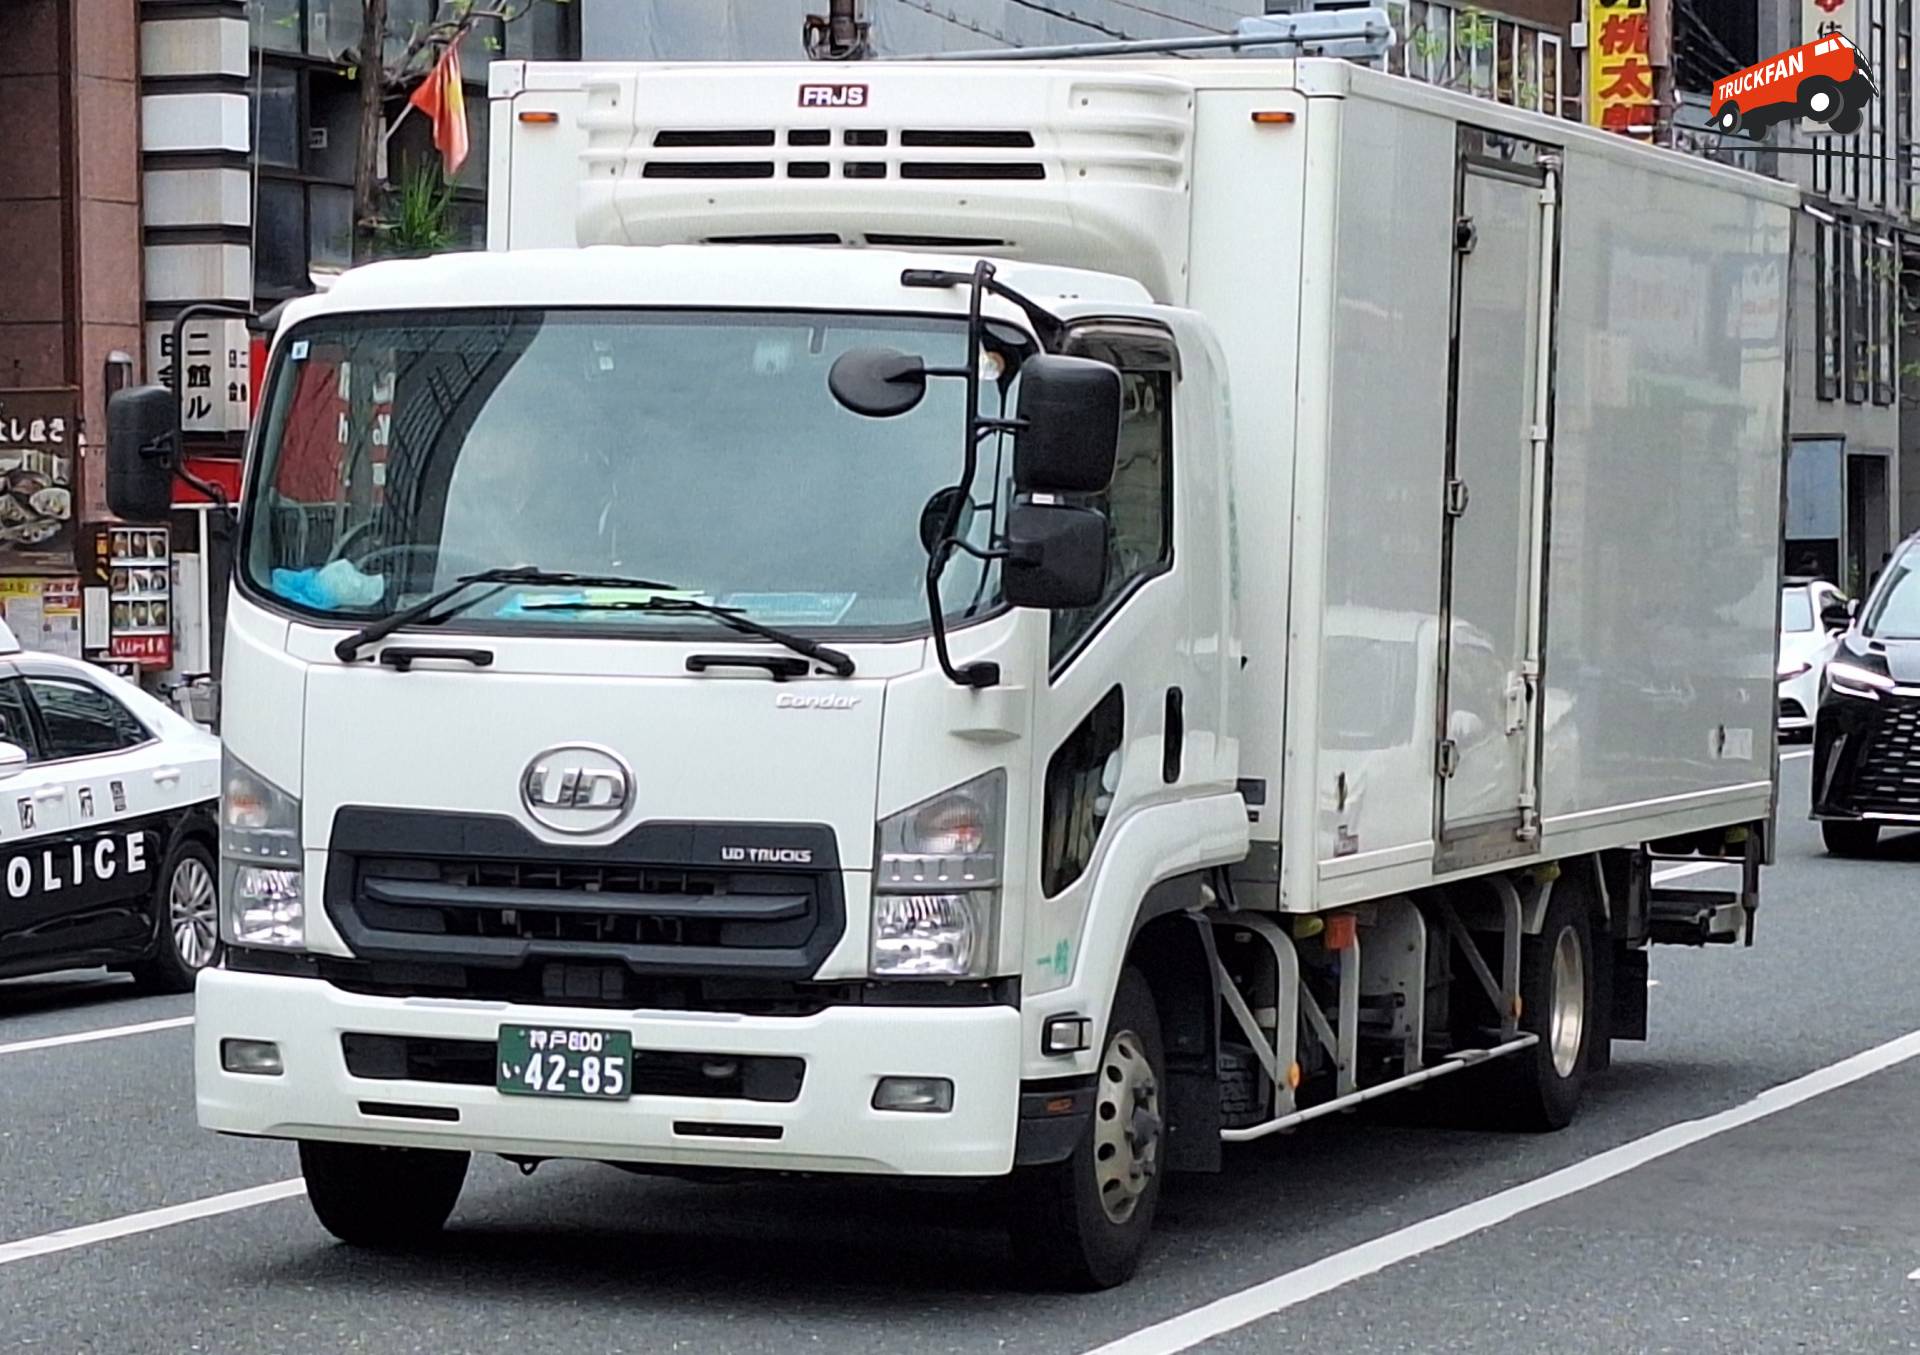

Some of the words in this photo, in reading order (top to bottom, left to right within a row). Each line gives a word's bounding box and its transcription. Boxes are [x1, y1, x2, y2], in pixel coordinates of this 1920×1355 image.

[776, 693, 860, 709] Condor
[528, 766, 626, 810] UD
[7, 831, 146, 898] OLICE
[721, 847, 745, 861] UD
[750, 848, 813, 863] TRUCKS
[502, 1062, 520, 1079] い
[524, 1053, 625, 1095] 42-85
